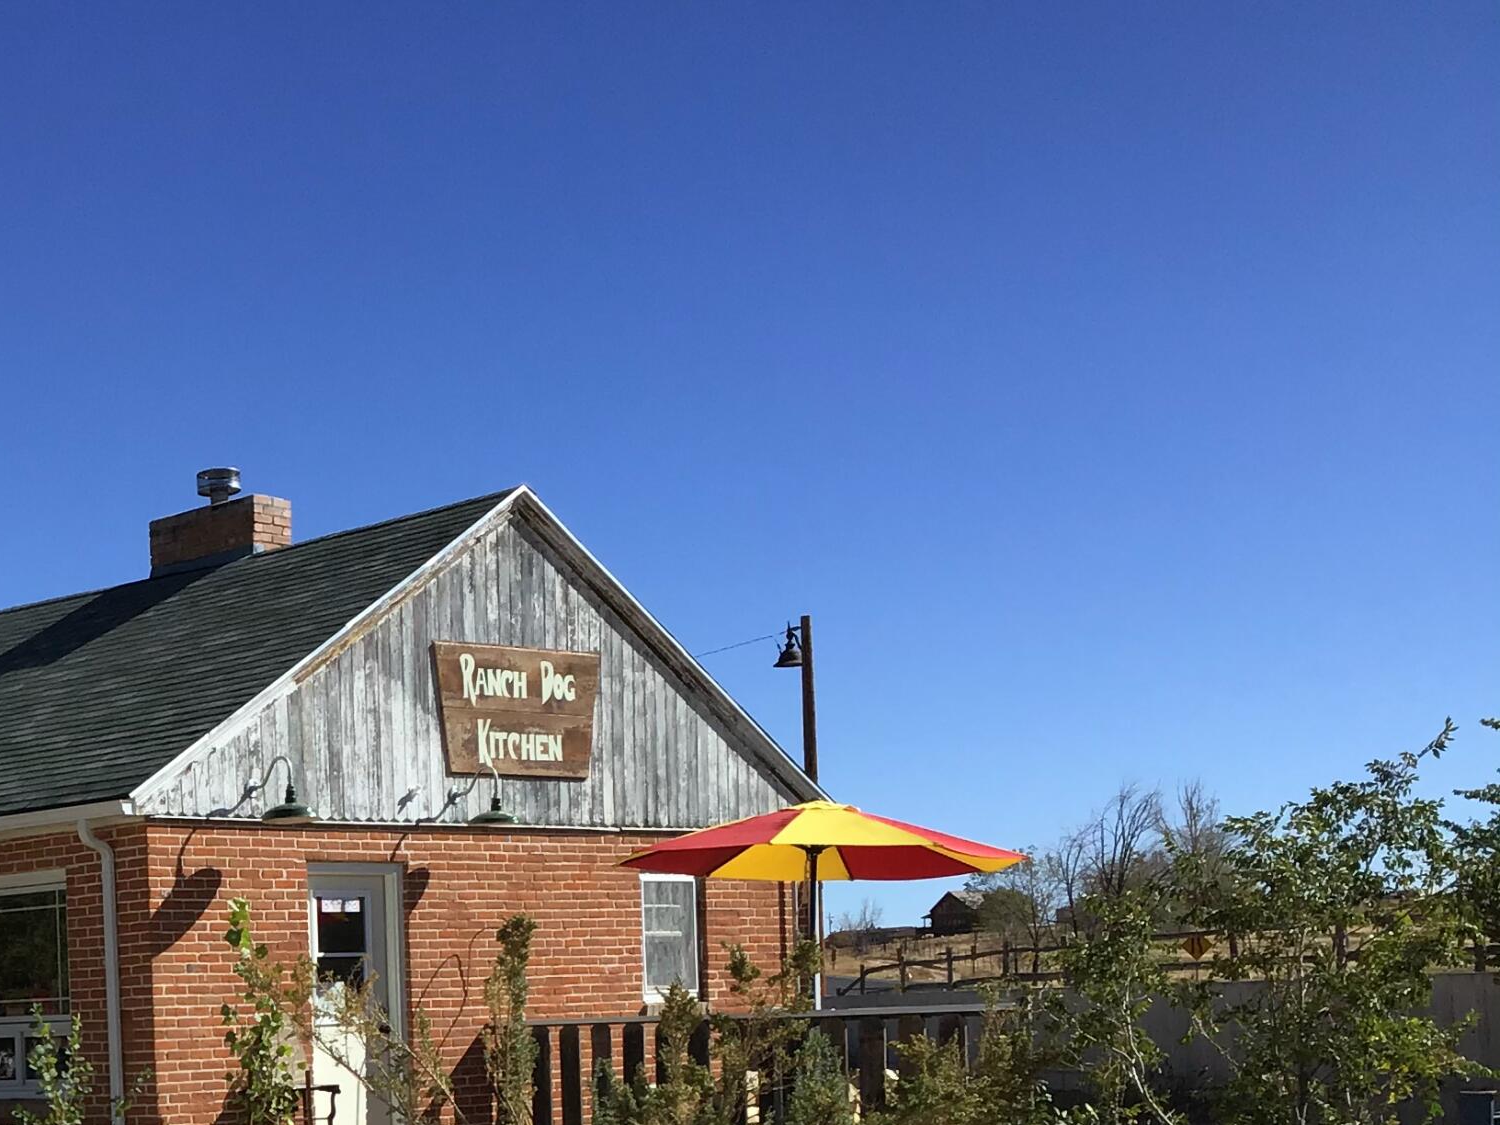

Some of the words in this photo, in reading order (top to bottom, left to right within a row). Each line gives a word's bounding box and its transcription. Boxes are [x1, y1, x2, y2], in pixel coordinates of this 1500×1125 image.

[459, 653, 528, 707] RANCH
[540, 660, 577, 705] DOG
[477, 718, 563, 768] KITCHEN
